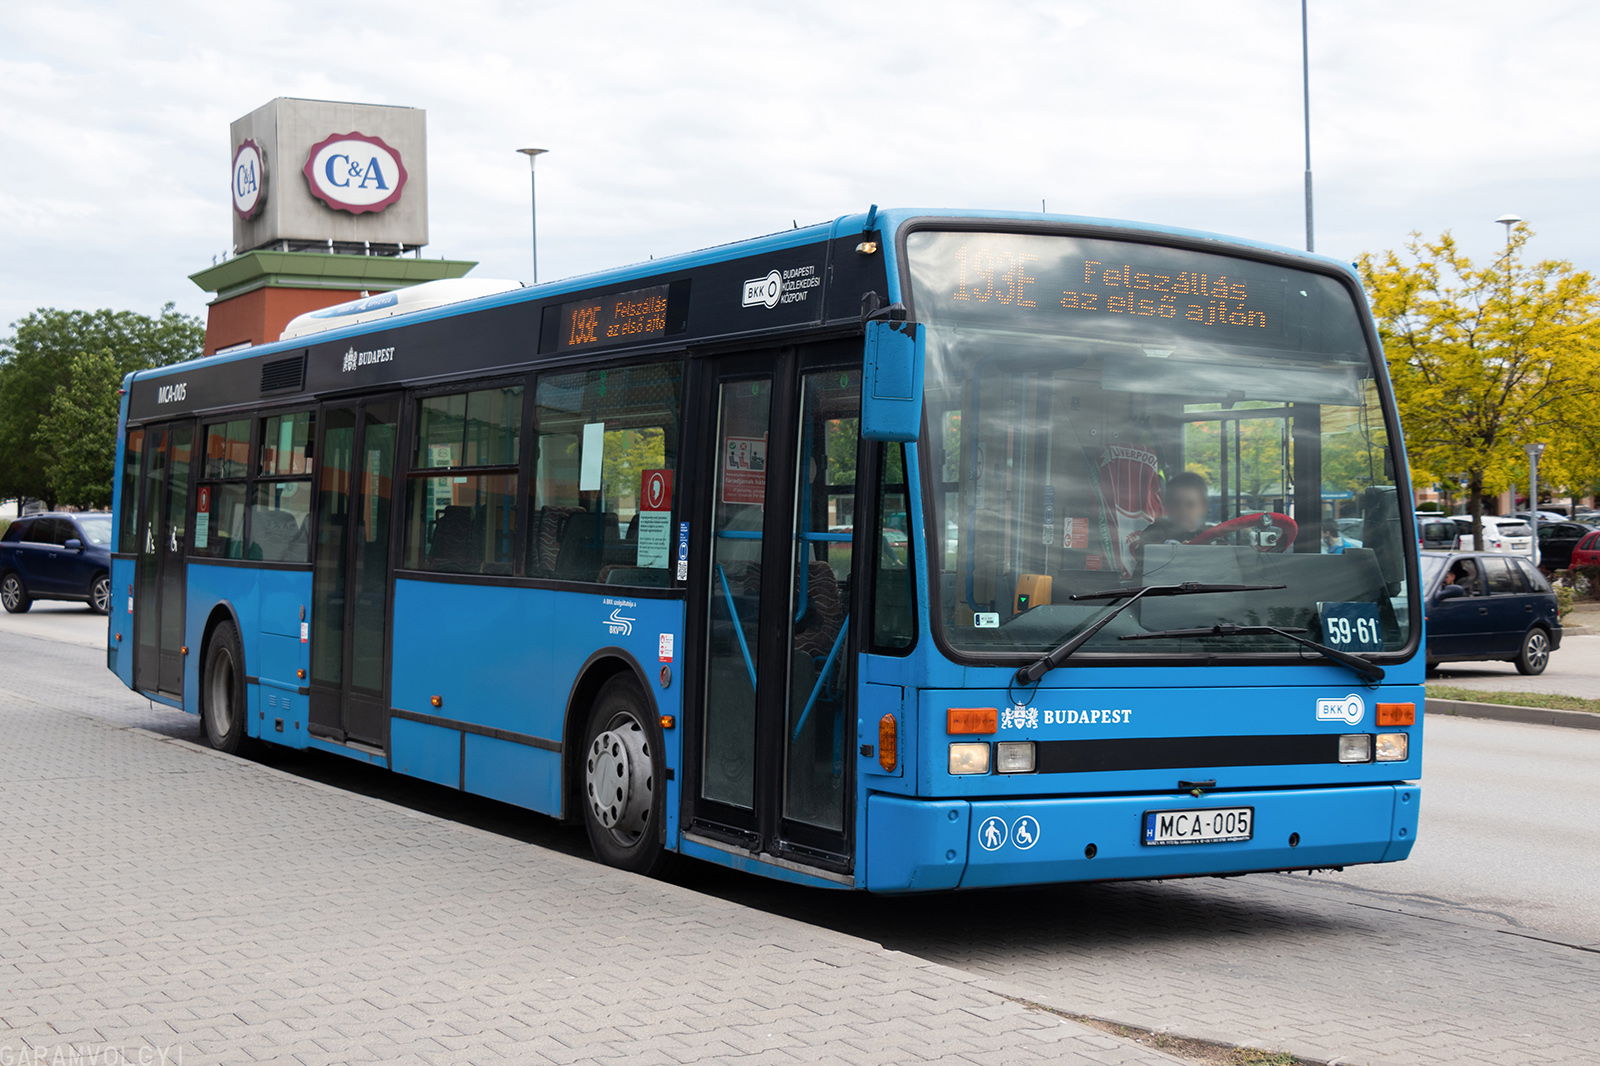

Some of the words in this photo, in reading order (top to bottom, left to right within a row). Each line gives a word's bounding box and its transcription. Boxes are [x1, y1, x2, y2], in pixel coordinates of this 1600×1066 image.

[237, 159, 258, 198] C&A
[325, 154, 389, 190] C&A
[783, 265, 816, 280] BUDAPESTI
[953, 246, 1040, 308] 193E
[1083, 259, 1248, 301] Felszállás
[747, 286, 765, 298] BKK
[780, 291, 809, 304] KÖZPONT
[614, 295, 667, 319] Felszállás
[1060, 290, 1098, 311] az
[1106, 291, 1177, 319] első
[1184, 299, 1267, 328] ajtón
[606, 324, 620, 337] az
[358, 347, 396, 366] BUDAPEST
[158, 382, 188, 404] MCA-005
[1327, 617, 1379, 644] 59-61
[1043, 708, 1132, 725] BUDAPEST
[1323, 704, 1343, 715] BKK
[1146, 829, 1153, 838] H
[1160, 812, 1248, 838] MCA-005
